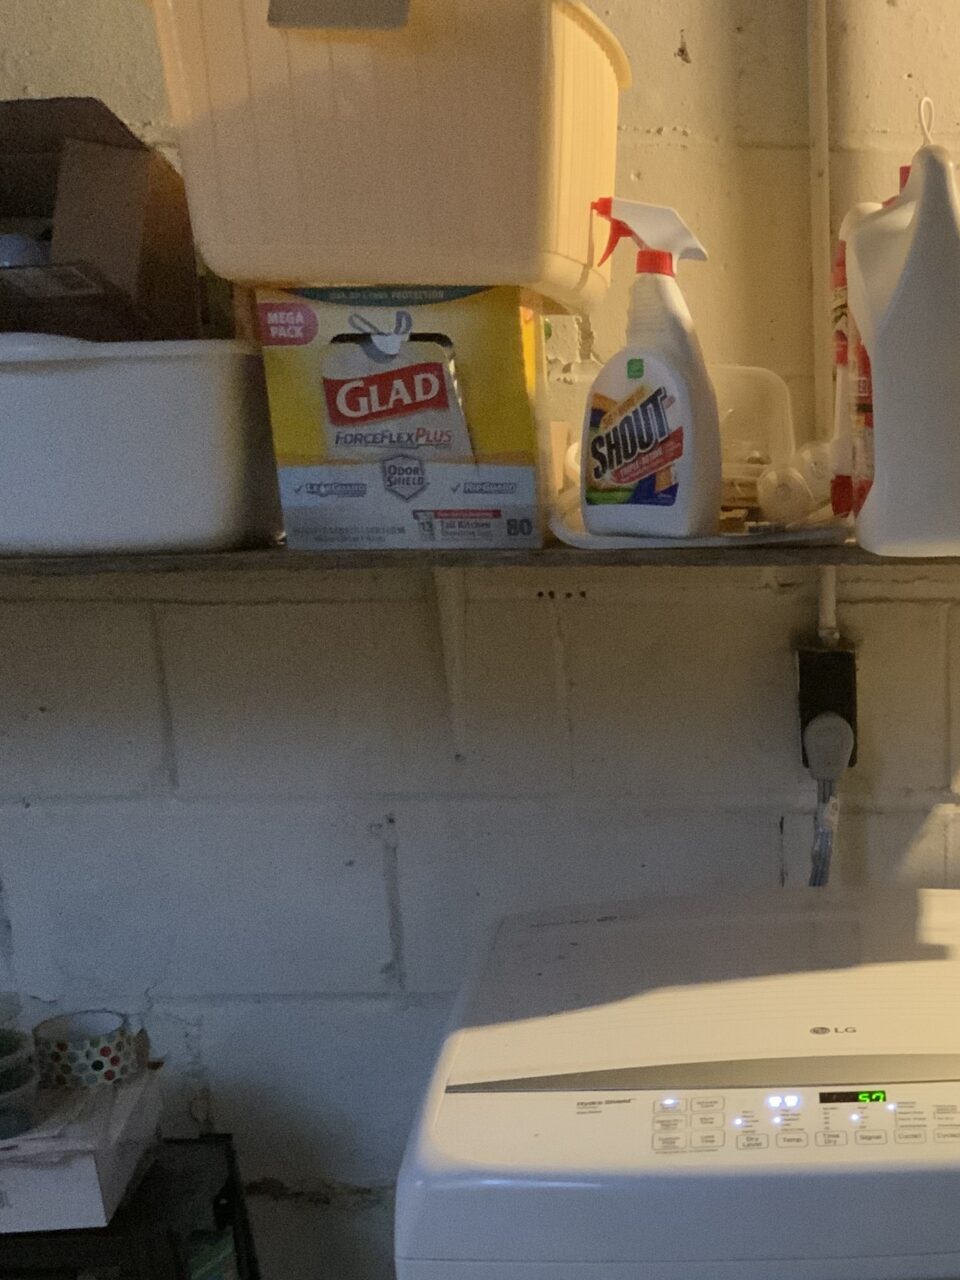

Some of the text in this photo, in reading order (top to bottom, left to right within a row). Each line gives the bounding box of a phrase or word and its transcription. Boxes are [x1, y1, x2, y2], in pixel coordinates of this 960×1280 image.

[267, 312, 304, 324] MEGA
[270, 326, 303, 338] PACK
[335, 372, 440, 418] GLAD
[591, 387, 670, 479] SHOUT
[387, 465, 420, 476] ODOR
[386, 475, 425, 487] SHIELD
[506, 518, 533, 536] 80
